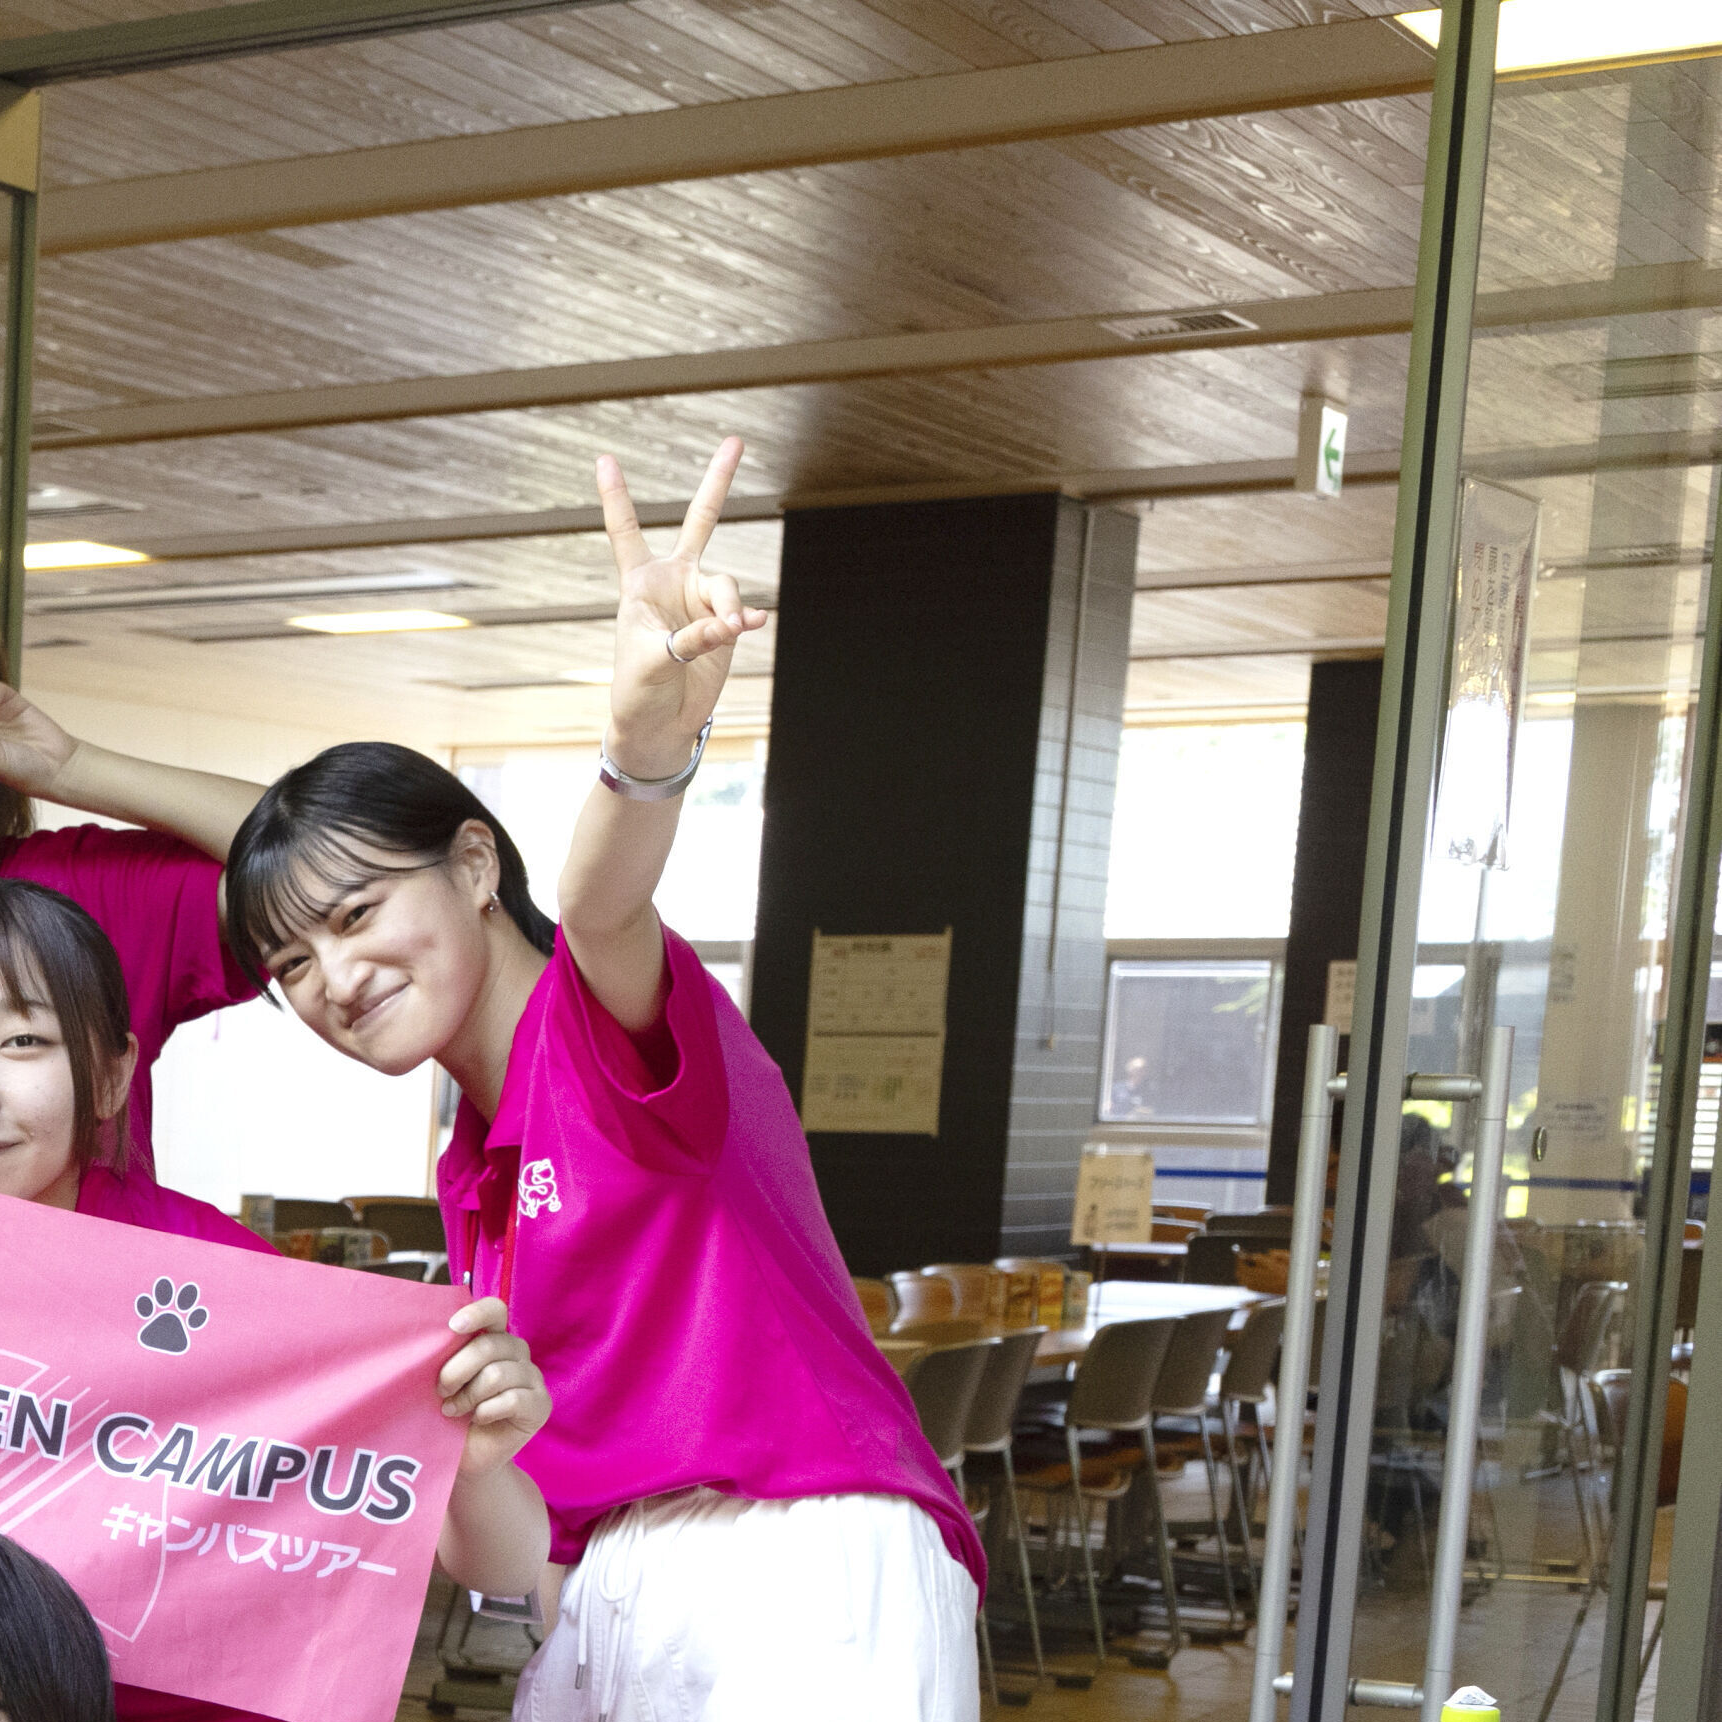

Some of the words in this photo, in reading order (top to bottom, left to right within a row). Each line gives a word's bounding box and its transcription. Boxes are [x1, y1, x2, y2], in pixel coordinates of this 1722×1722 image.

[90, 1410, 423, 1526] CAMPUS
[100, 1503, 398, 1580] キャンパスツアー
